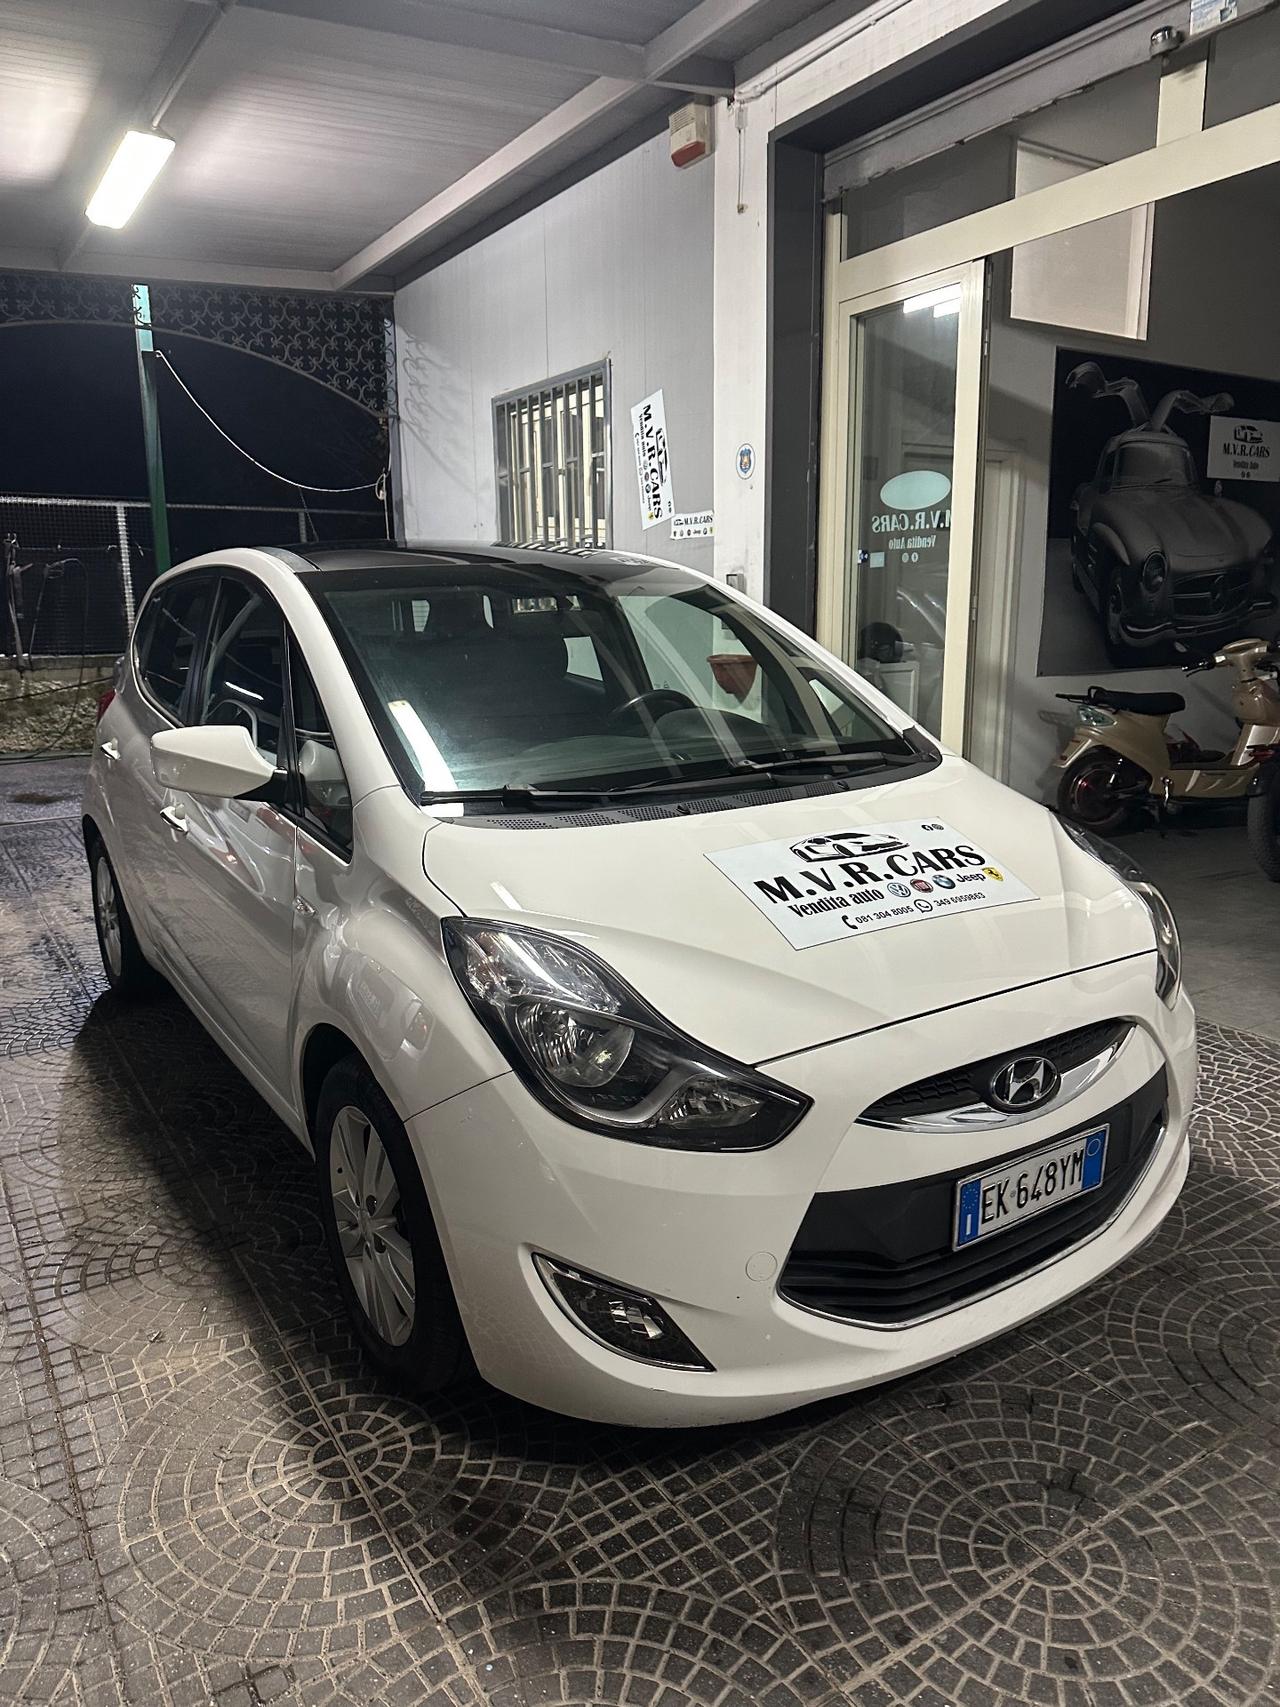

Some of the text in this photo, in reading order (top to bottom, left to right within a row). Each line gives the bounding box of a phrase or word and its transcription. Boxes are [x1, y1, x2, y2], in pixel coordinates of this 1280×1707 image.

[643, 404, 663, 519] M.V.R.CARS
[1223, 443, 1270, 457] M.V.R.CARS
[754, 845, 986, 904] M.V.R.CARS
[788, 872, 986, 918] Vendita auto Jeep
[855, 913, 873, 925] 081
[874, 909, 892, 920] 304
[892, 905, 914, 916] 8005
[933, 897, 951, 907] 349
[981, 1178, 1010, 1225] EK
[1016, 1148, 1085, 1208] 648YM
